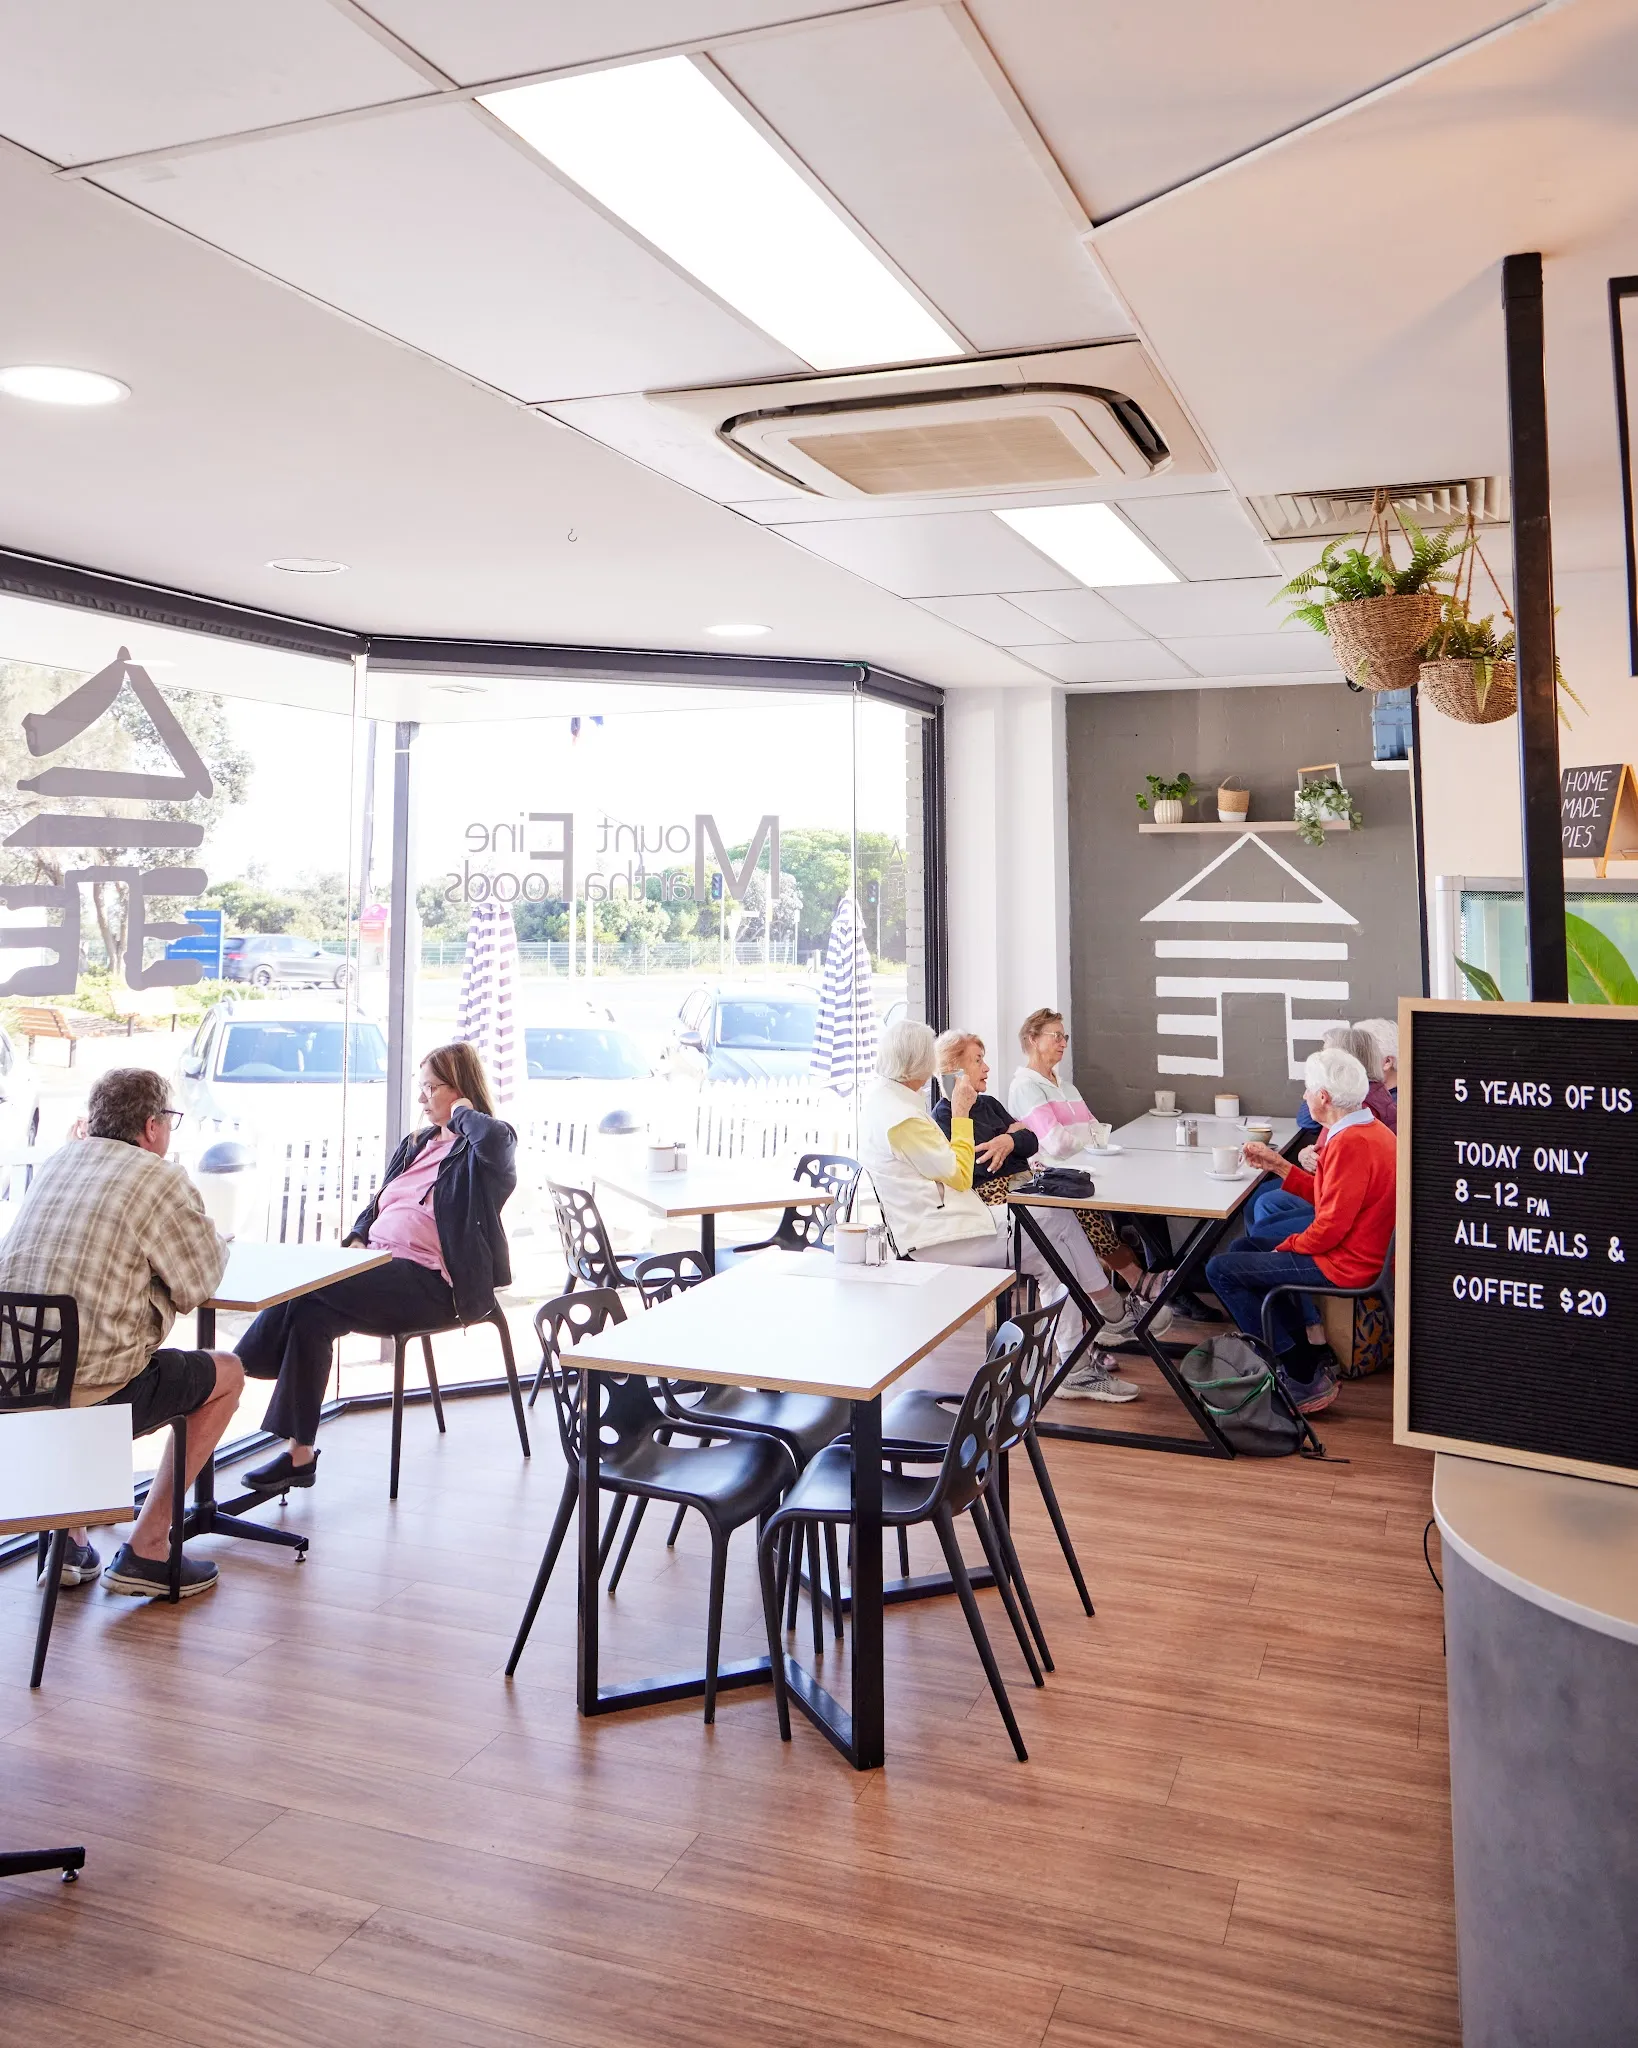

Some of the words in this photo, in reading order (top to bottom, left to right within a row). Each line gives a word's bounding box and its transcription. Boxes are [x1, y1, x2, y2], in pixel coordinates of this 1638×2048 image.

[1565, 770, 1612, 792] HOME
[1561, 797, 1605, 818] MADE
[1562, 825, 1596, 848] PIES
[1454, 1078, 1468, 1102] 5
[1480, 1081, 1552, 1106] YEARS
[1565, 1085, 1594, 1110] OF
[1601, 1088, 1633, 1113] US
[1454, 1140, 1520, 1169] TODAY
[1533, 1147, 1588, 1175] ONLY
[1526, 1197, 1550, 1217] PM
[1454, 1219, 1497, 1249] ALL
[1508, 1227, 1588, 1259] MEALS
[1608, 1236, 1625, 1263] &
[1453, 1274, 1544, 1309] COFFEE
[1560, 1288, 1607, 1318] $20
